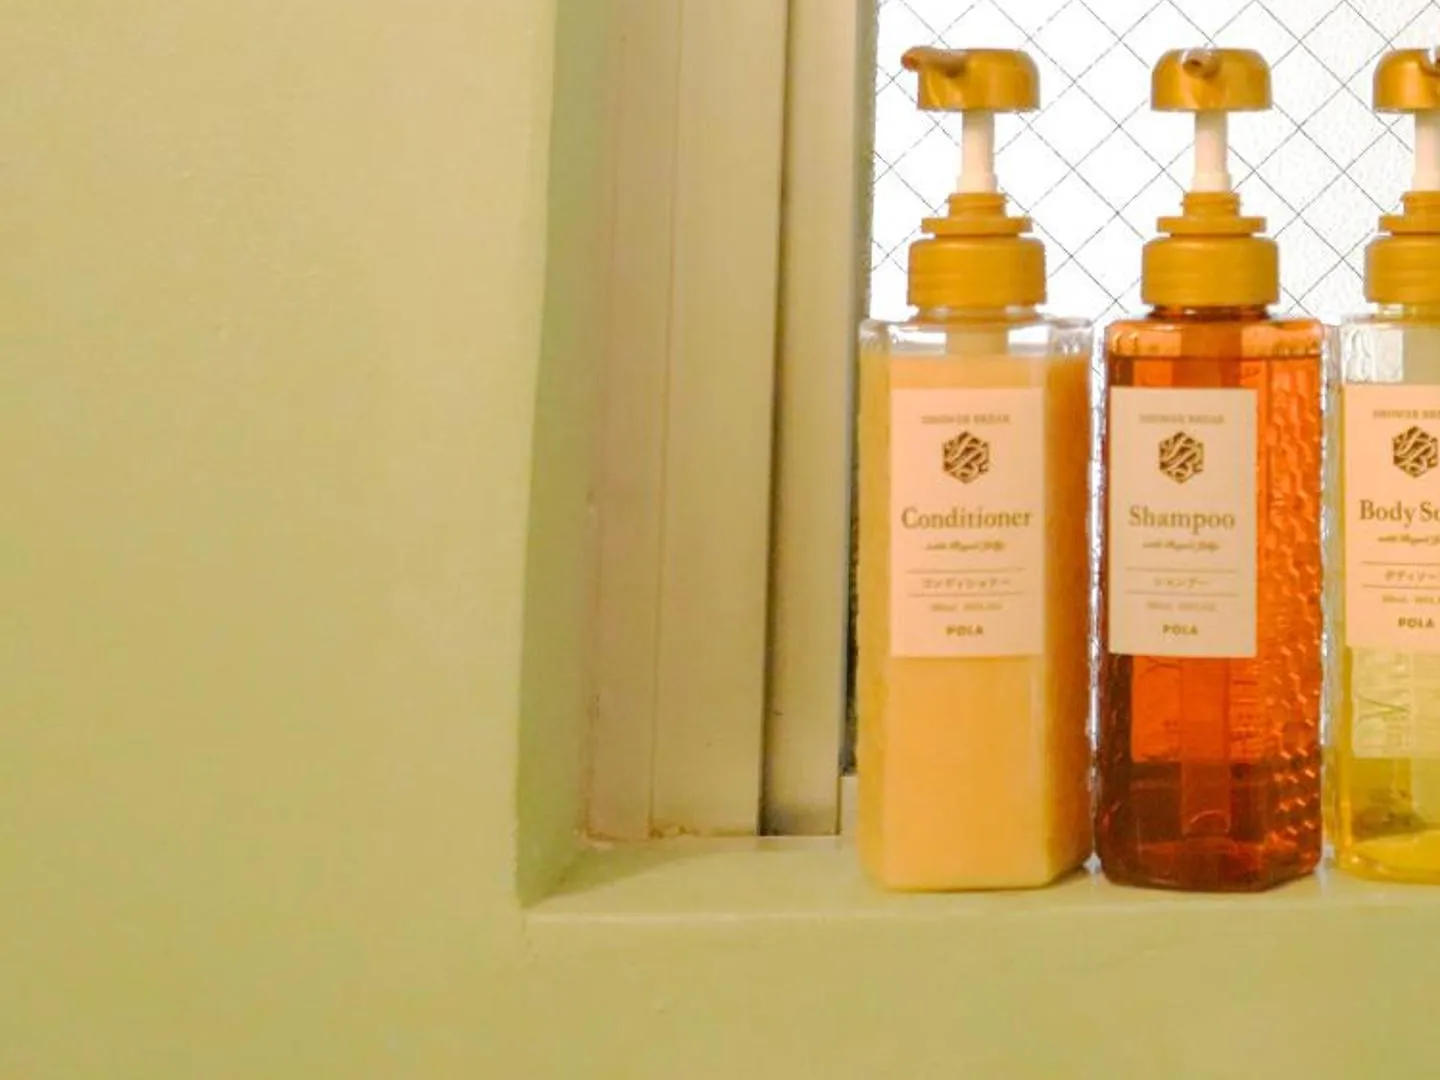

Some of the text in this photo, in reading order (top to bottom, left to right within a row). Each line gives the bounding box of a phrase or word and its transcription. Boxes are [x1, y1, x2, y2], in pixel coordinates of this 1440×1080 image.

[901, 505, 1033, 530] Conditioner
[1128, 504, 1237, 535] Shampoo
[1359, 499, 1416, 528] Body
[946, 624, 984, 637] POLA
[1162, 624, 1199, 636] POLA
[1397, 617, 1435, 629] POLA
